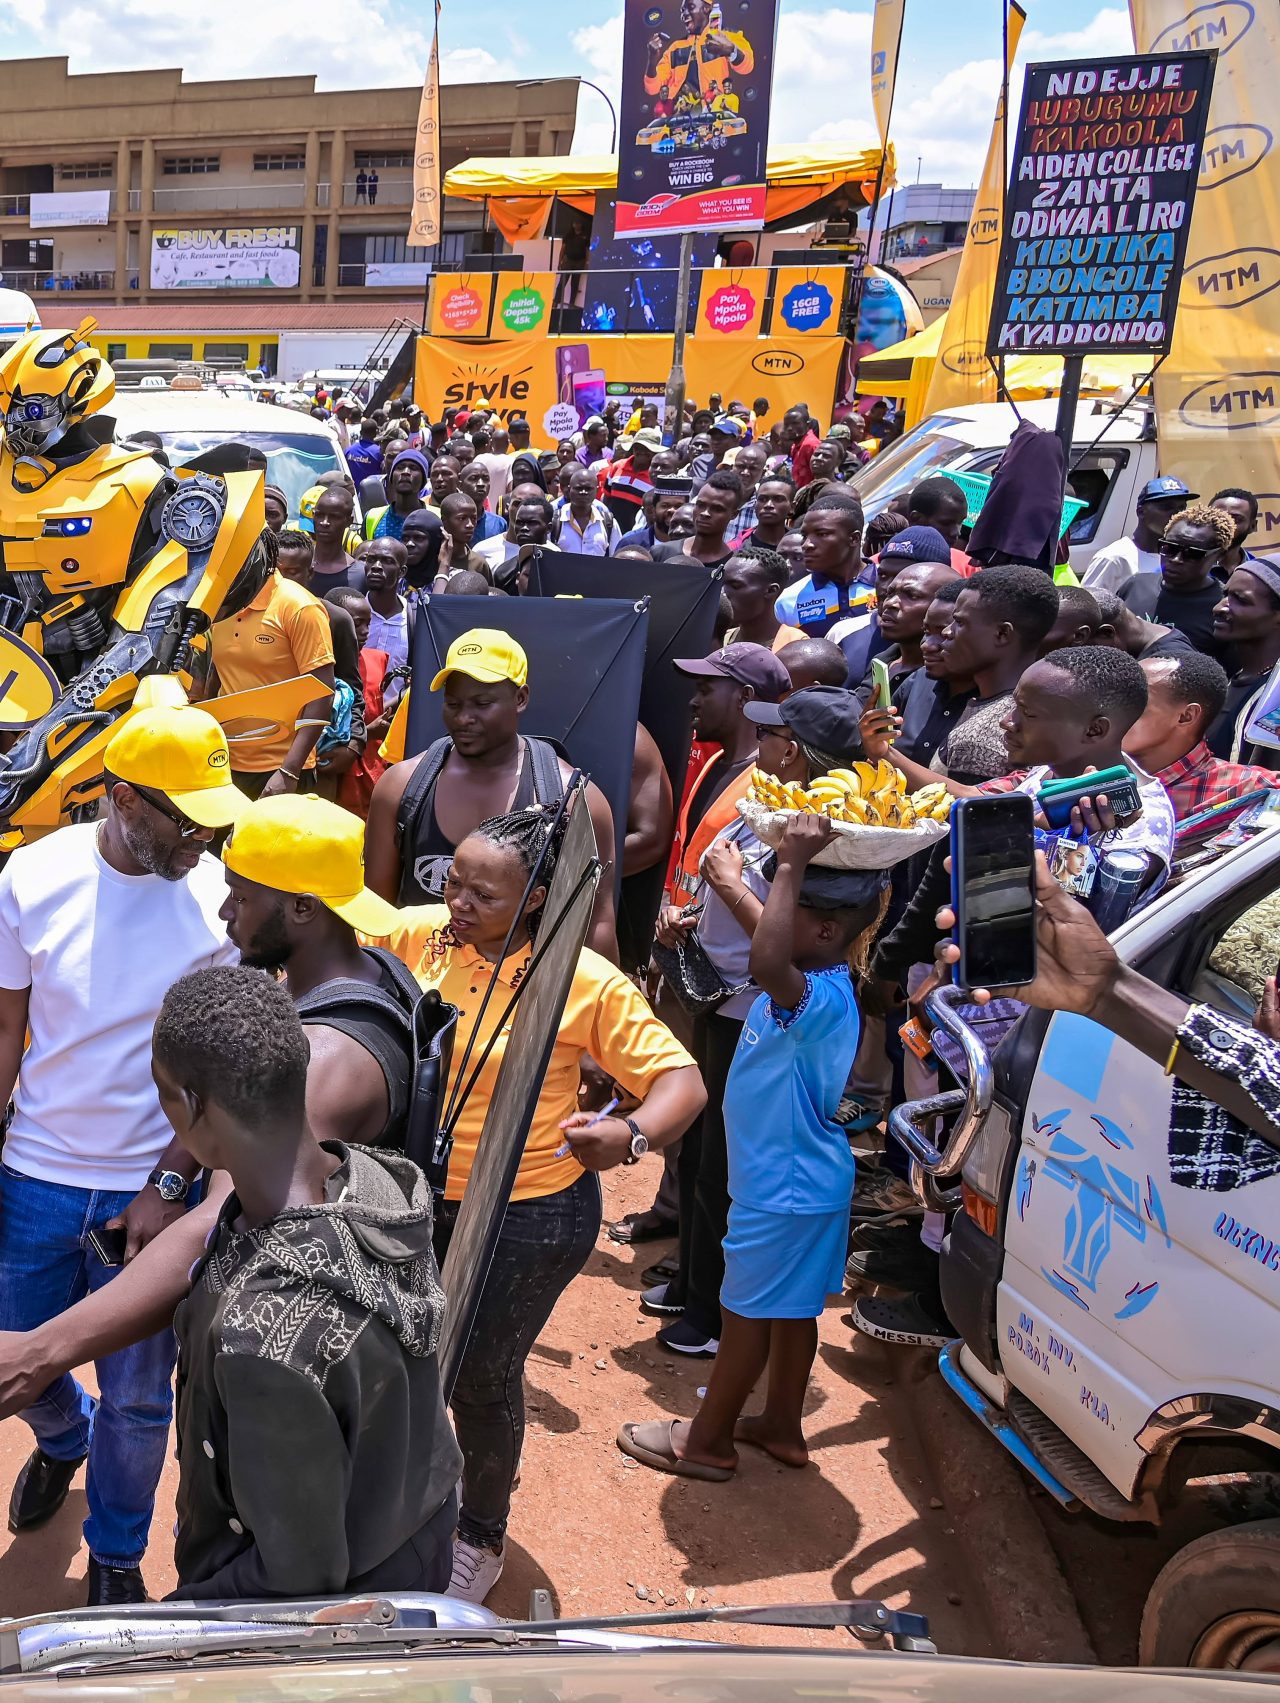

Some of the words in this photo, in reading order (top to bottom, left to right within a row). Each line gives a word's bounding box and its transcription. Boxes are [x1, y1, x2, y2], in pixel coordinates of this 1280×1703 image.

[1047, 64, 1185, 97] NDEJJE
[1026, 89, 1198, 127] LUBUGUMU
[1030, 117, 1184, 153] KAKOOLA
[1019, 152, 1095, 181] AIDEN
[668, 173, 692, 186] WIN
[693, 171, 714, 184] BIG
[1032, 175, 1152, 208] ZANTA
[699, 199, 718, 207] WHAT
[702, 206, 721, 215] WHAT
[721, 205, 735, 213] YOU
[176, 230, 223, 250] BUY
[225, 227, 297, 249] FRESH
[190, 252, 229, 260] Restaurant
[230, 251, 244, 259] and
[245, 251, 259, 260] fast
[259, 250, 280, 260] foods
[1015, 231, 1176, 267] KIBUTIKA
[509, 297, 535, 308] Initial
[719, 294, 740, 305] Pay
[792, 296, 820, 309] 16GB
[505, 305, 540, 317] Deposit
[713, 302, 747, 316] Mpola
[792, 306, 820, 318] FREE
[1006, 293, 1163, 322] KATIMBA
[513, 315, 531, 325] 45k
[714, 312, 747, 325] Mpola
[997, 321, 1166, 349] KYADDONDO
[764, 357, 792, 369] MTN
[629, 386, 658, 394] Kabode
[553, 411, 568, 419] Pay
[549, 417, 573, 427] Mpola
[550, 425, 574, 434] Mpola
[796, 598, 826, 610] buxton
[873, 1328, 923, 1345] MESSI
